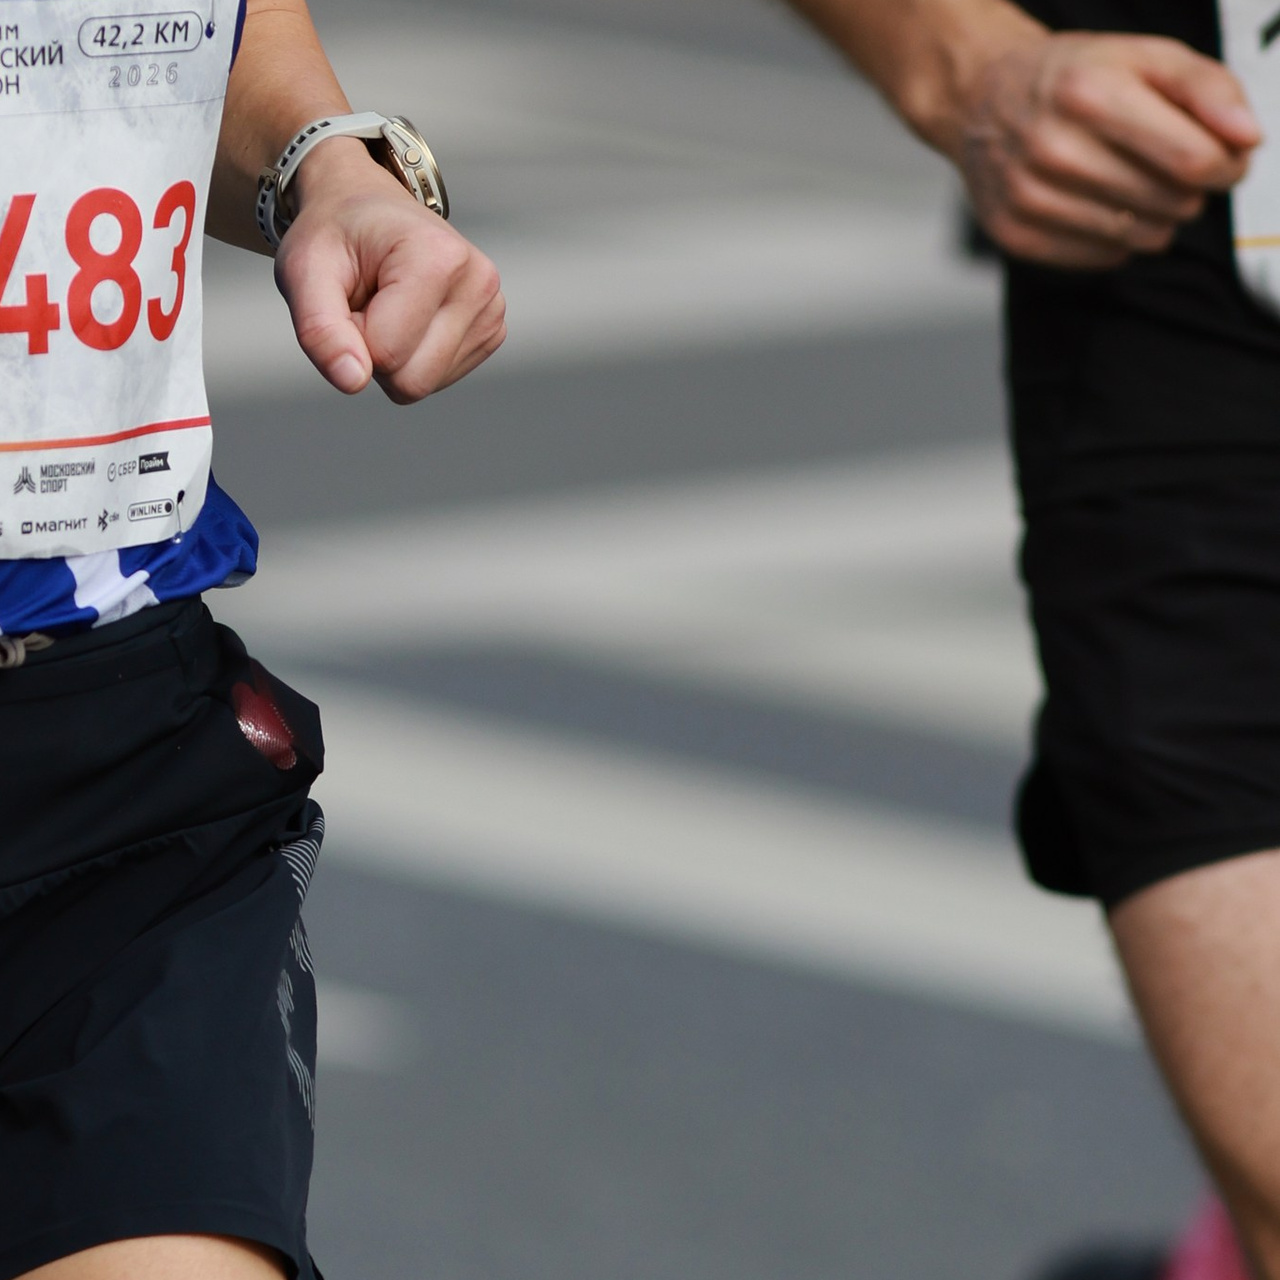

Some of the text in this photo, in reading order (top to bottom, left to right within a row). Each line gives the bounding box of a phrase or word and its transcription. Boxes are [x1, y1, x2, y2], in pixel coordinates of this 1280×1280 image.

[93, 20, 190, 50] 42,2 КМ
[108, 62, 179, 88] 2026
[40, 458, 95, 478] МОСКОВСКИЙ
[117, 457, 164, 477] СБЕР Прайм
[40, 479, 68, 493] СПОРТ
[130, 504, 163, 518] WINLINE
